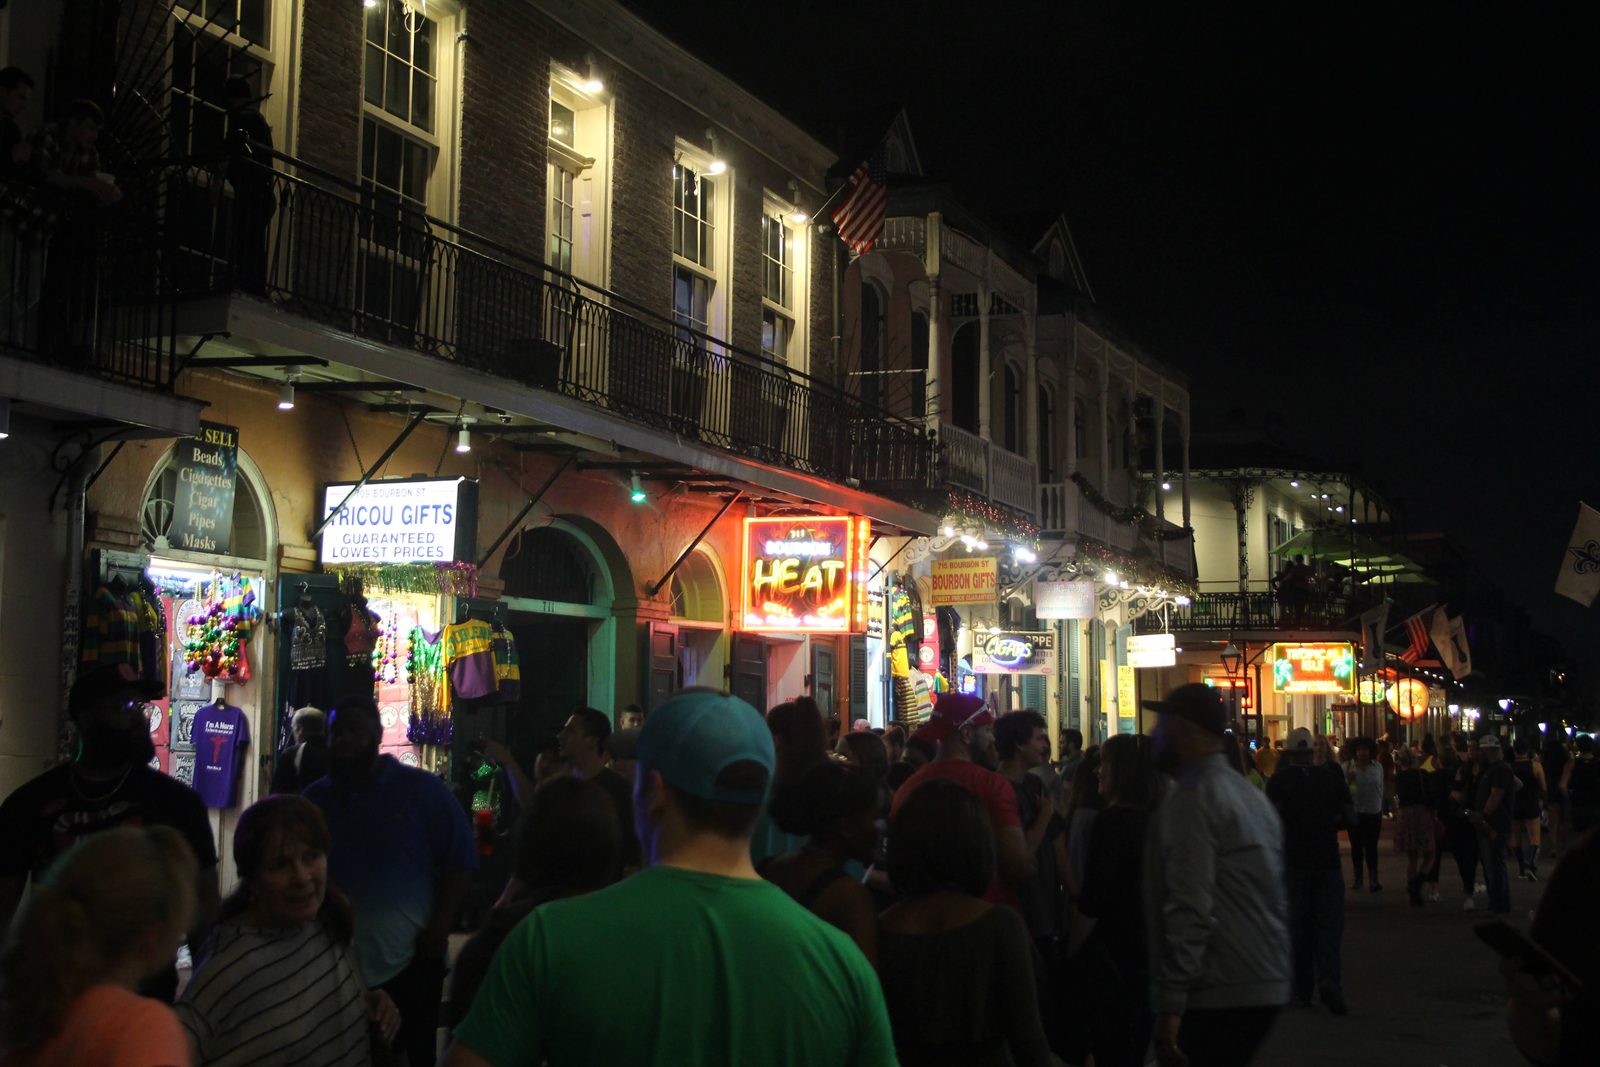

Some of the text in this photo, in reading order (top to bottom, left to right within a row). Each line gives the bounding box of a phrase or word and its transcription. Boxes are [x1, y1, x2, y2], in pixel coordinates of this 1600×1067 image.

[205, 428, 236, 447] SELL
[180, 467, 232, 489] Cigarettes
[373, 488, 412, 498] BOURBON
[188, 511, 216, 531] Pipes
[329, 503, 453, 526] TRICOU GIFTS
[182, 532, 216, 551] Masks
[342, 532, 435, 545] GUARANTEED
[332, 545, 444, 558] LOWEST PRICES
[949, 560, 979, 569] BOURBON
[981, 560, 989, 568] ST
[753, 557, 845, 604] HEAT
[932, 571, 996, 590] BOURBON GIFTS
[985, 637, 1033, 658] CIGARS
[219, 721, 234, 731] Nurse
